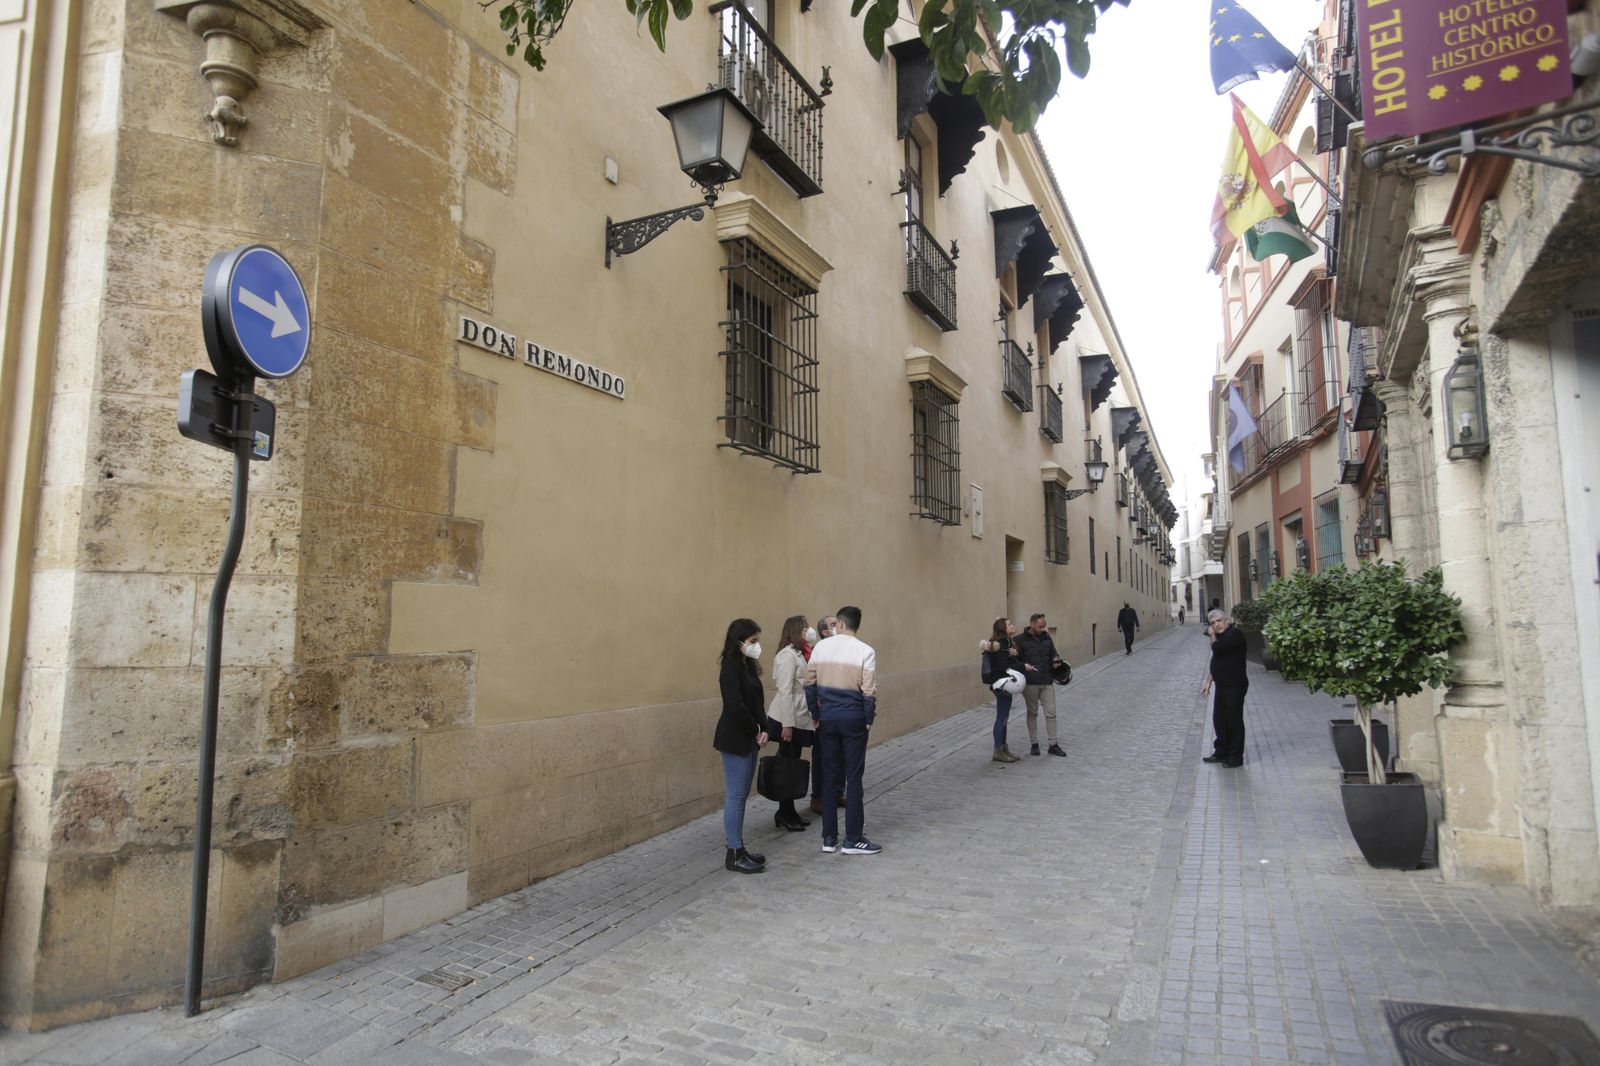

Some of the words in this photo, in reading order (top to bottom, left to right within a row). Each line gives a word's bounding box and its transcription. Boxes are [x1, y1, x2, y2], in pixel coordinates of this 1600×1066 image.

[1439, 0, 1534, 28] HOTEL
[1444, 7, 1537, 46] CENTRO
[1369, 8, 1407, 116] HOTEL
[1431, 24, 1554, 72] HISTÓRICO
[462, 318, 516, 357] DON
[526, 342, 625, 395] REMONDO
